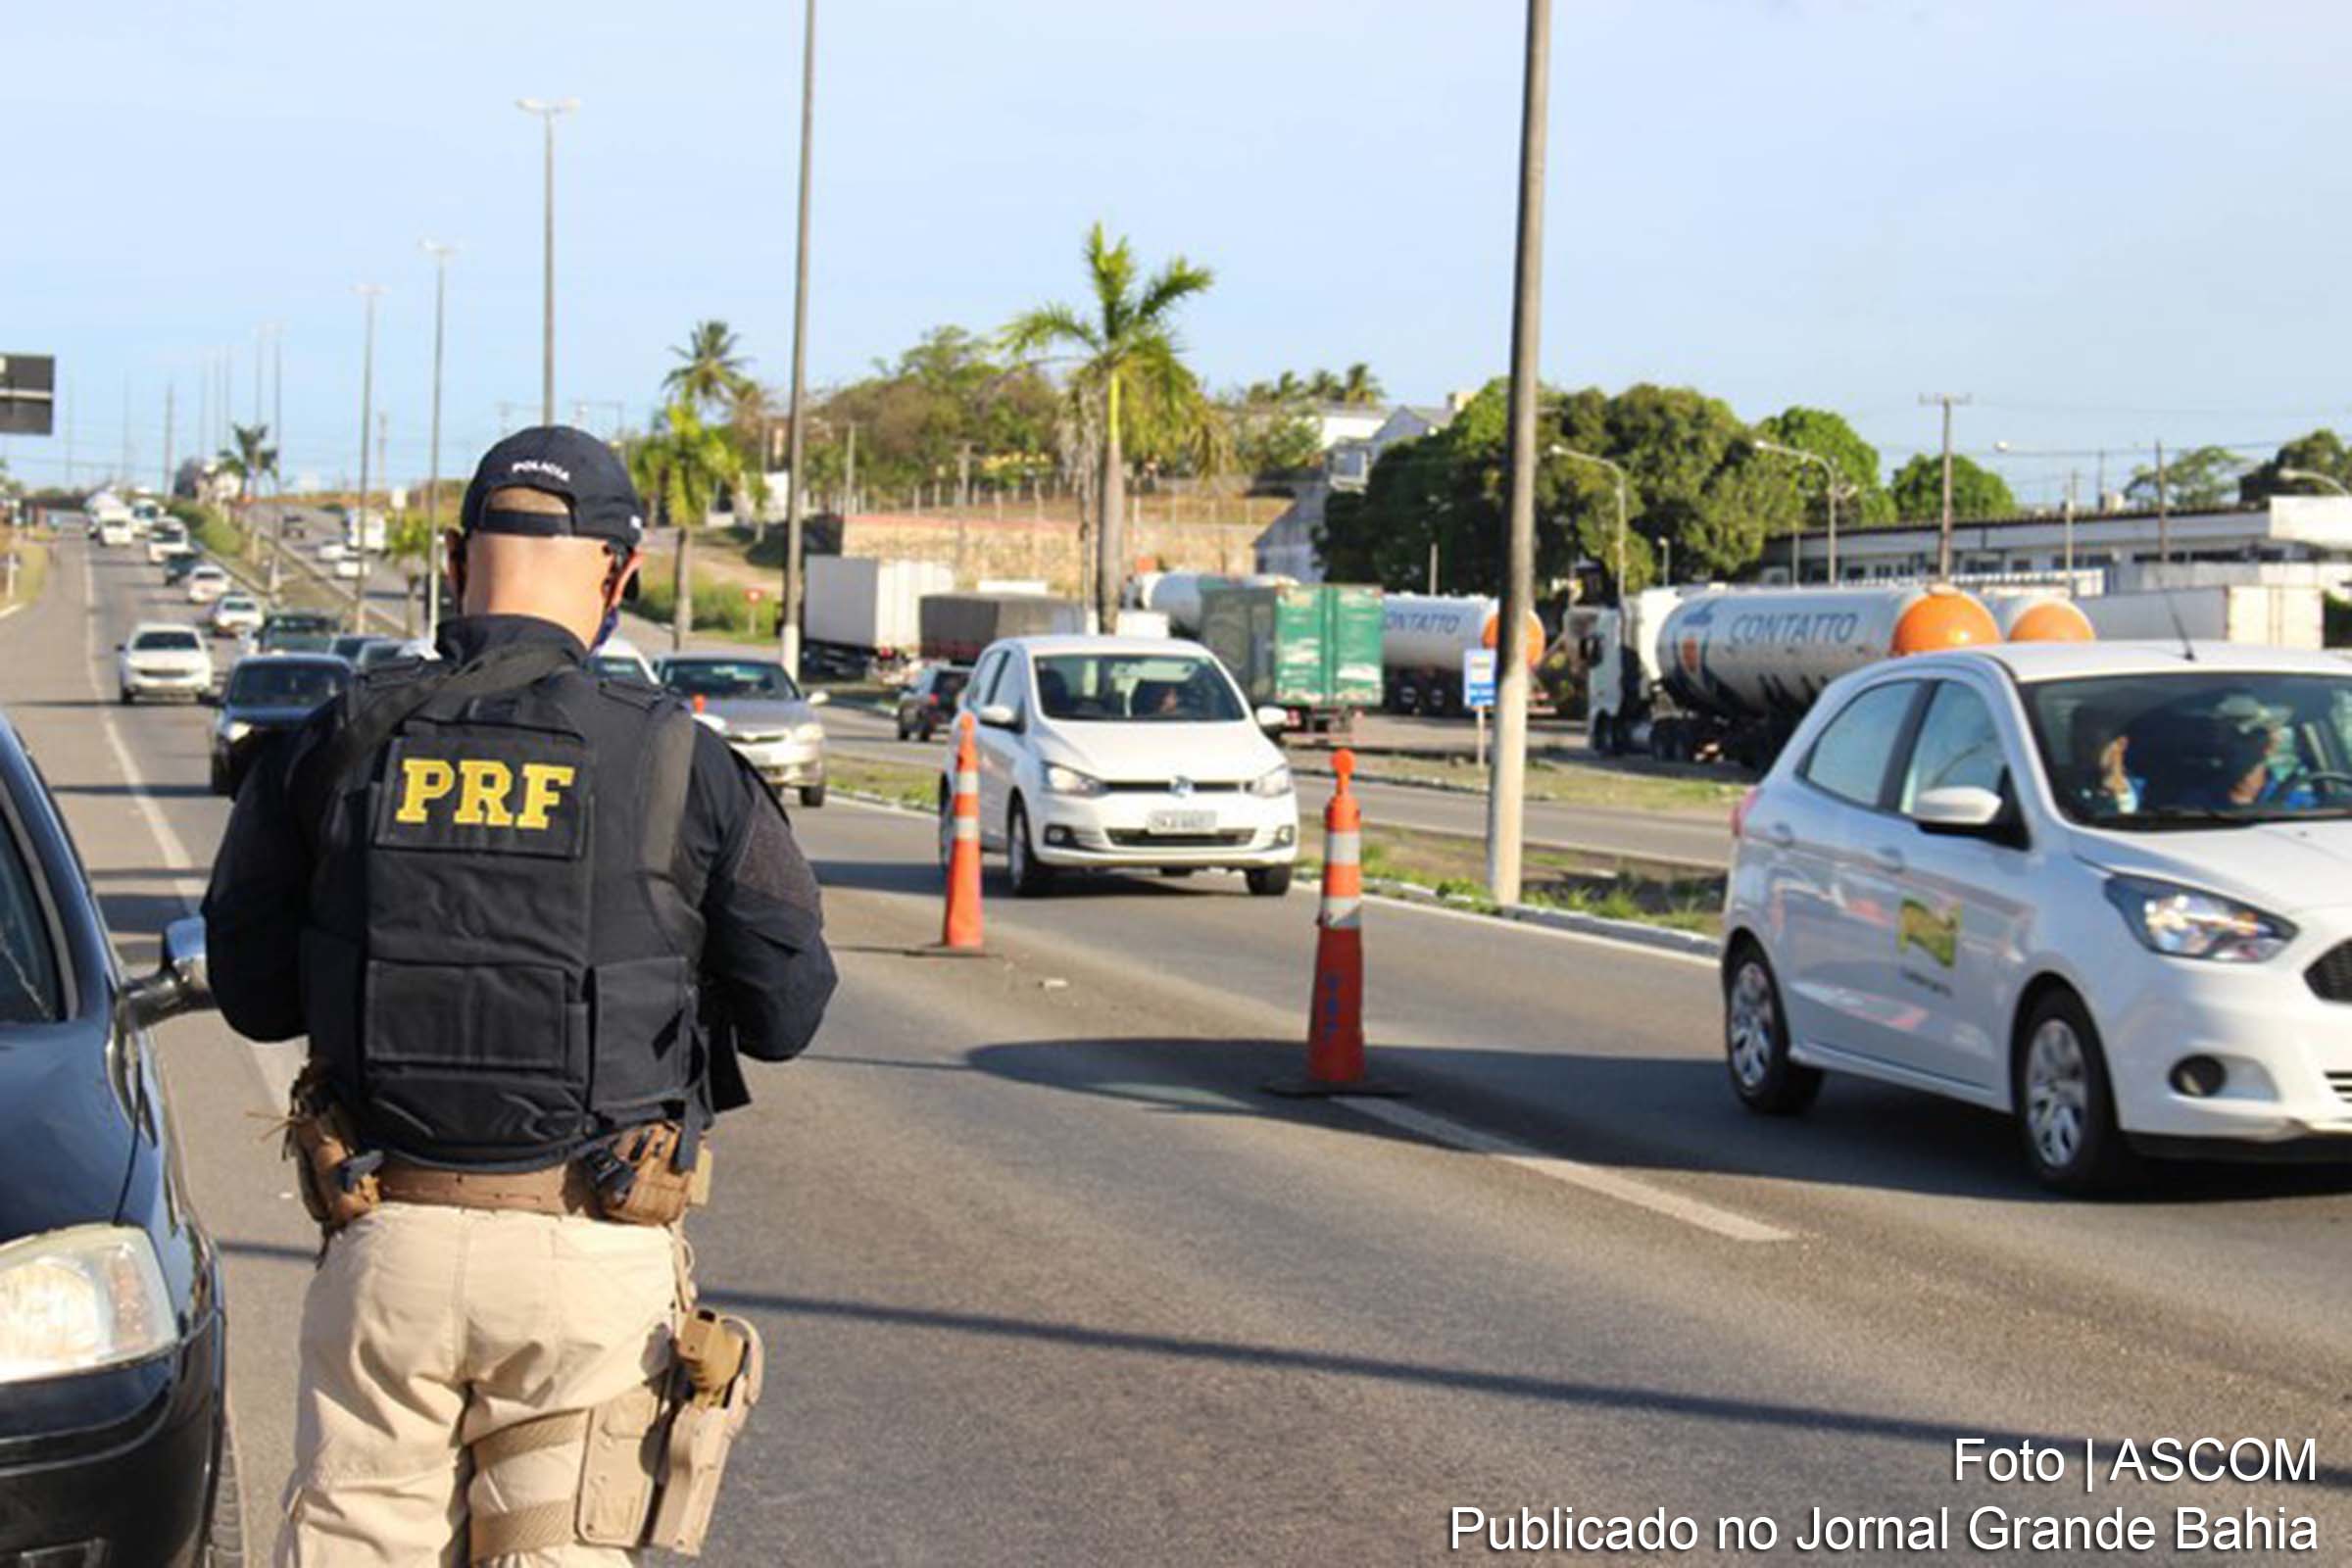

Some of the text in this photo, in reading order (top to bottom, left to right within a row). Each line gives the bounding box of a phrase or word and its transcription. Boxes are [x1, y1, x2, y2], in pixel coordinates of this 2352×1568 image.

[1384, 612, 1461, 635] ONTATTO
[1731, 612, 1858, 644] CONTATTO
[395, 758, 576, 830] PRF
